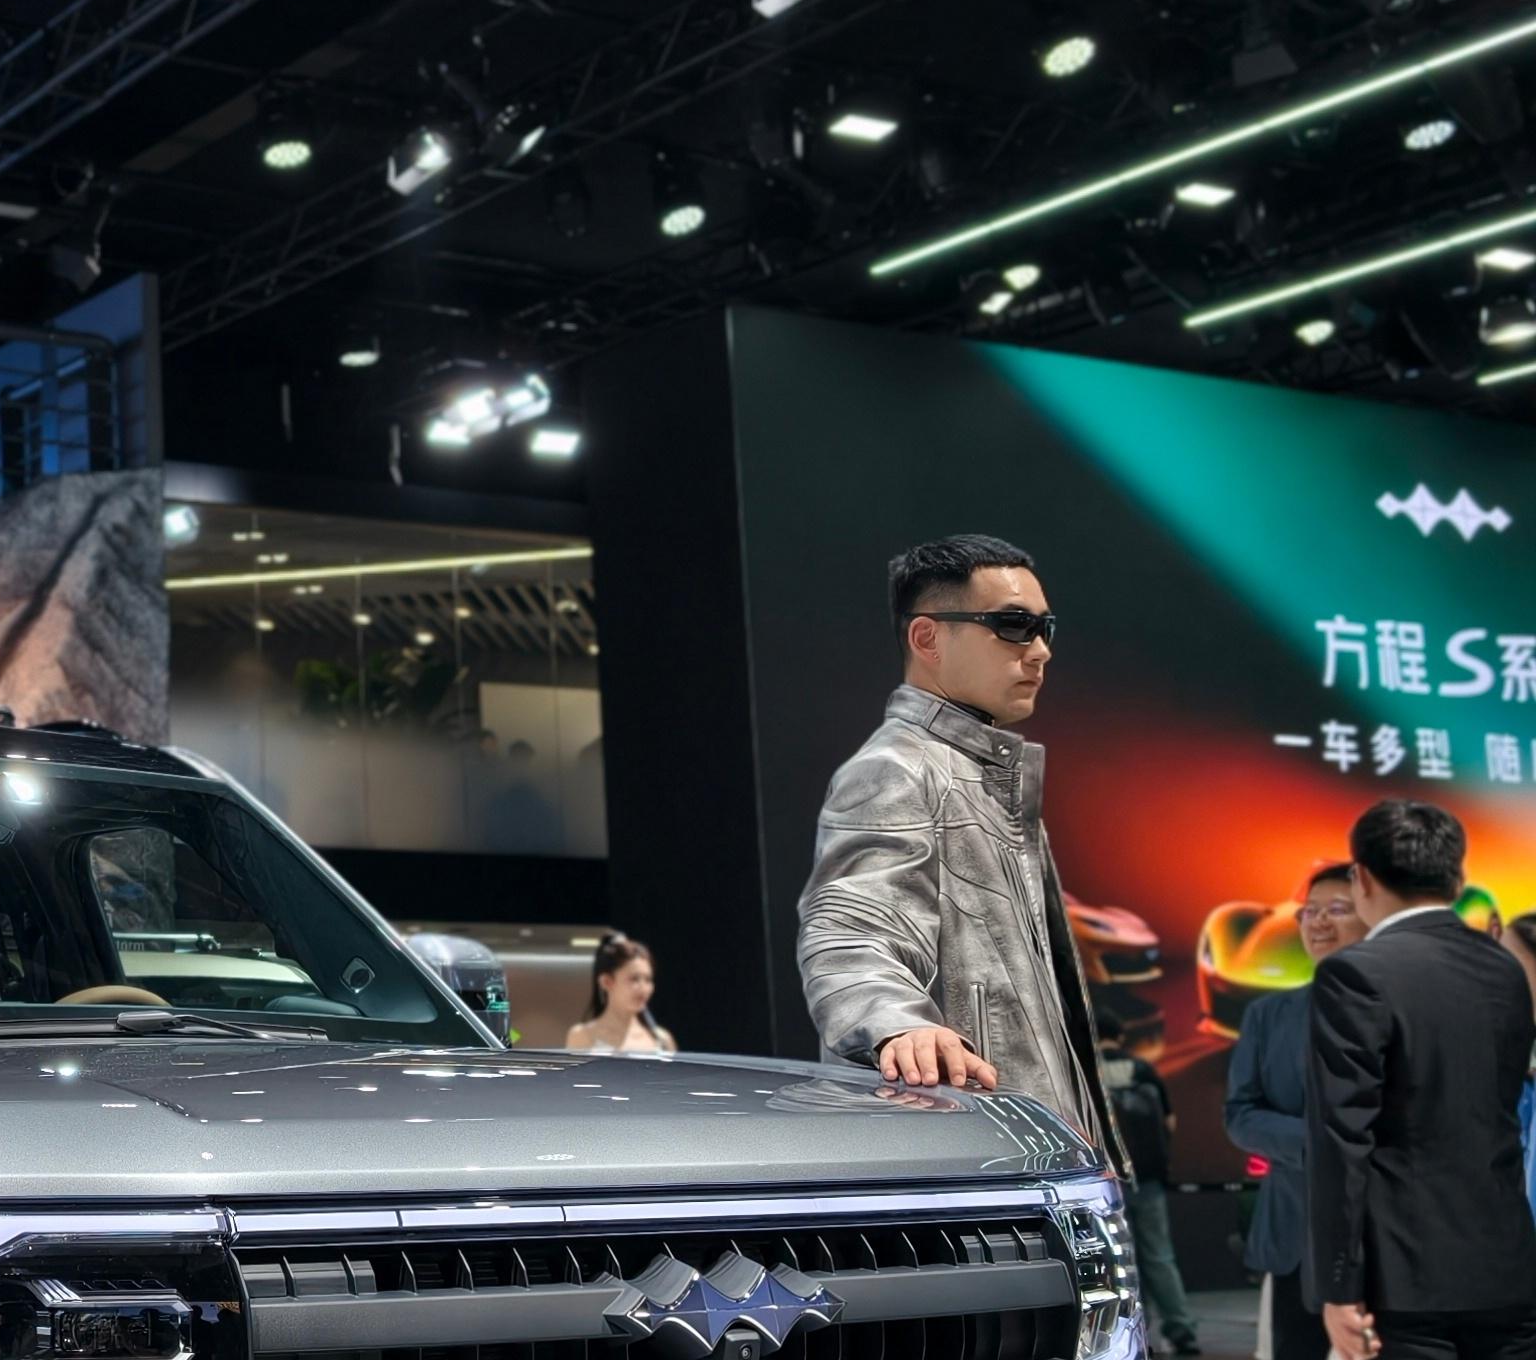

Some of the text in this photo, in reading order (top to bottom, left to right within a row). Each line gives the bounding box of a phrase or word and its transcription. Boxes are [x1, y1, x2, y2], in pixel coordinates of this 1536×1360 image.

[1274, 720, 1536, 784] 一车多型 随
